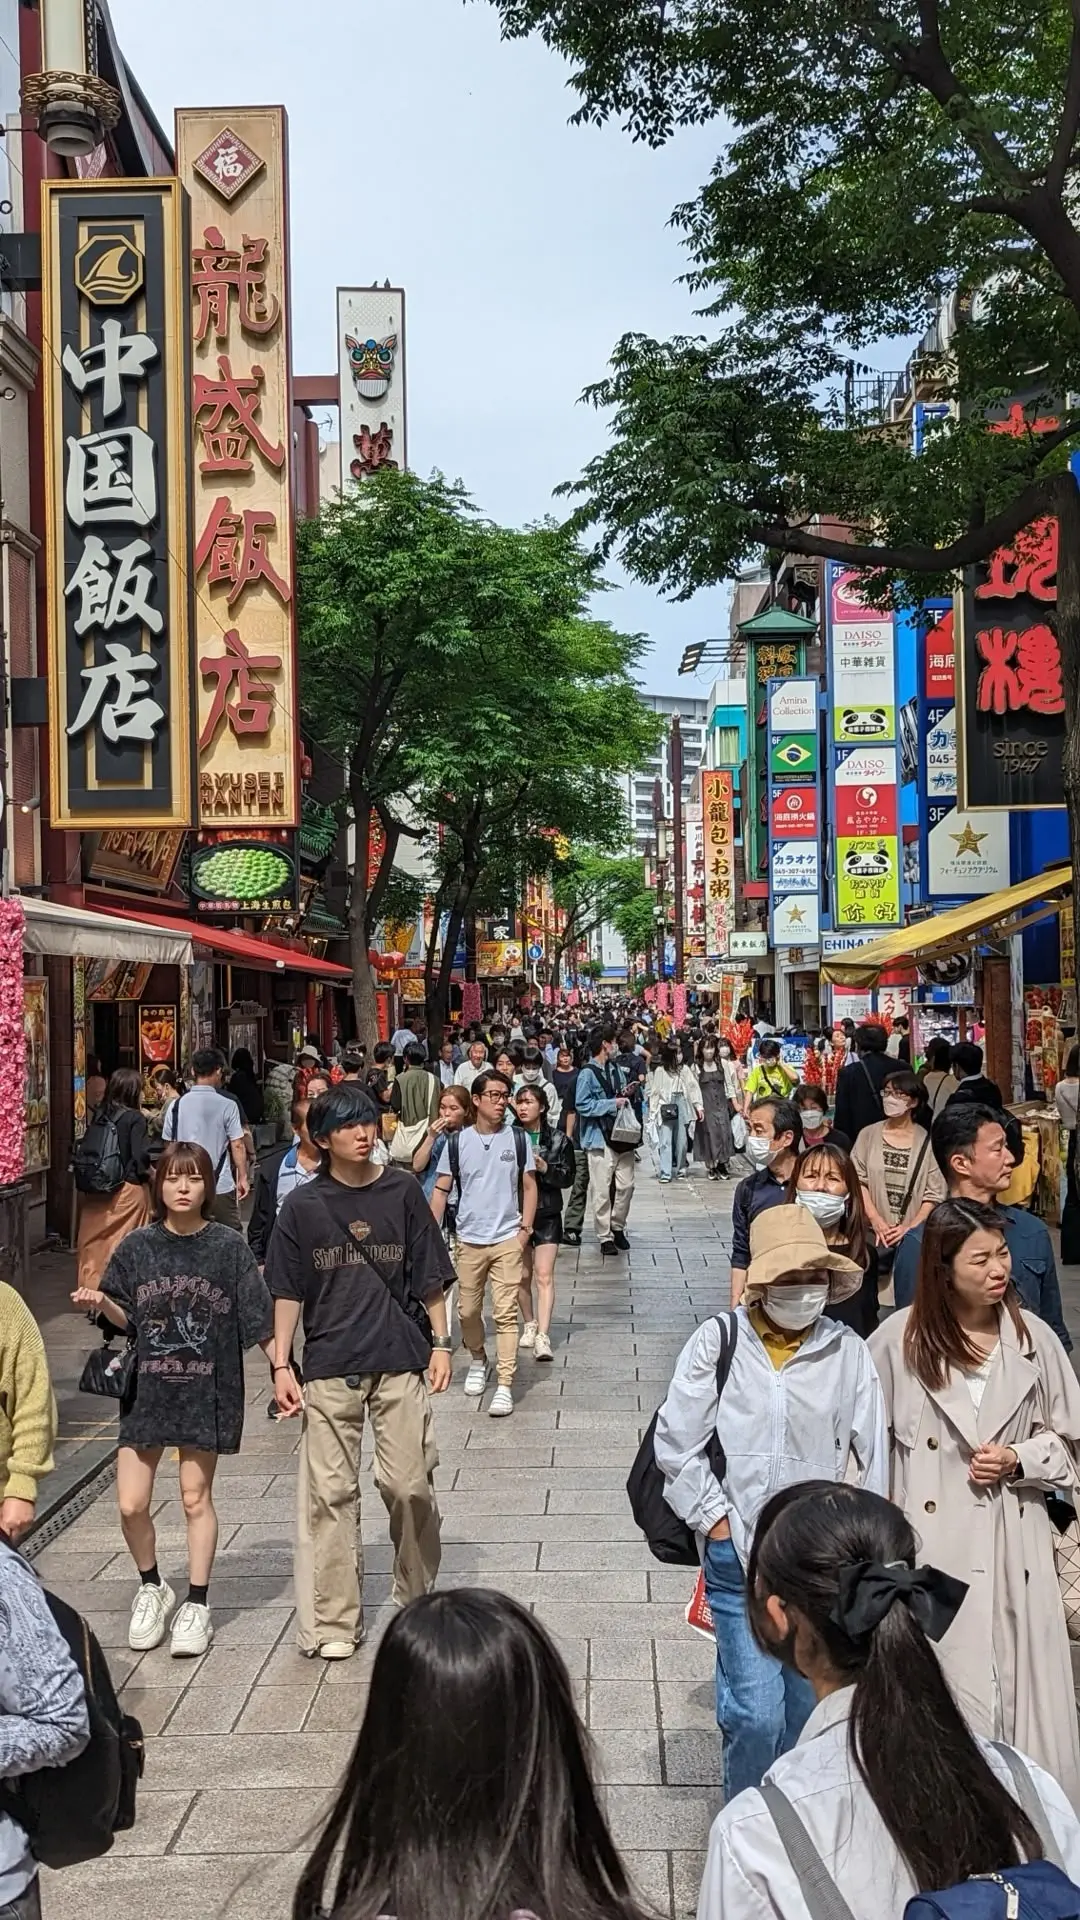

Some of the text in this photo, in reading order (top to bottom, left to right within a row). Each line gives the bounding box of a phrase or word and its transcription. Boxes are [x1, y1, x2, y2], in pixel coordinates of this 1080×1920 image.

[213, 148, 242, 180] 福
[192, 226, 285, 750] 龍盛飯店
[62, 318, 166, 743] 中国飯店
[844, 631, 882, 640] DAISO
[780, 696, 808, 705] Amina
[772, 706, 815, 716] Collection
[927, 708, 944, 723] 4F
[771, 736, 781, 745] 6F
[992, 738, 1049, 757] since
[837, 749, 849, 761] 1F
[847, 760, 885, 769] DAISO
[1003, 758, 1042, 773] 1947
[199, 772, 284, 787] RYUSEI
[200, 788, 284, 805] HANTEN
[772, 789, 783, 799] 5F
[929, 807, 946, 822] 3F
[707, 778, 730, 899] 小籠包・お粥
[774, 854, 817, 865] カラオケ
[824, 939, 864, 950] CHINA
